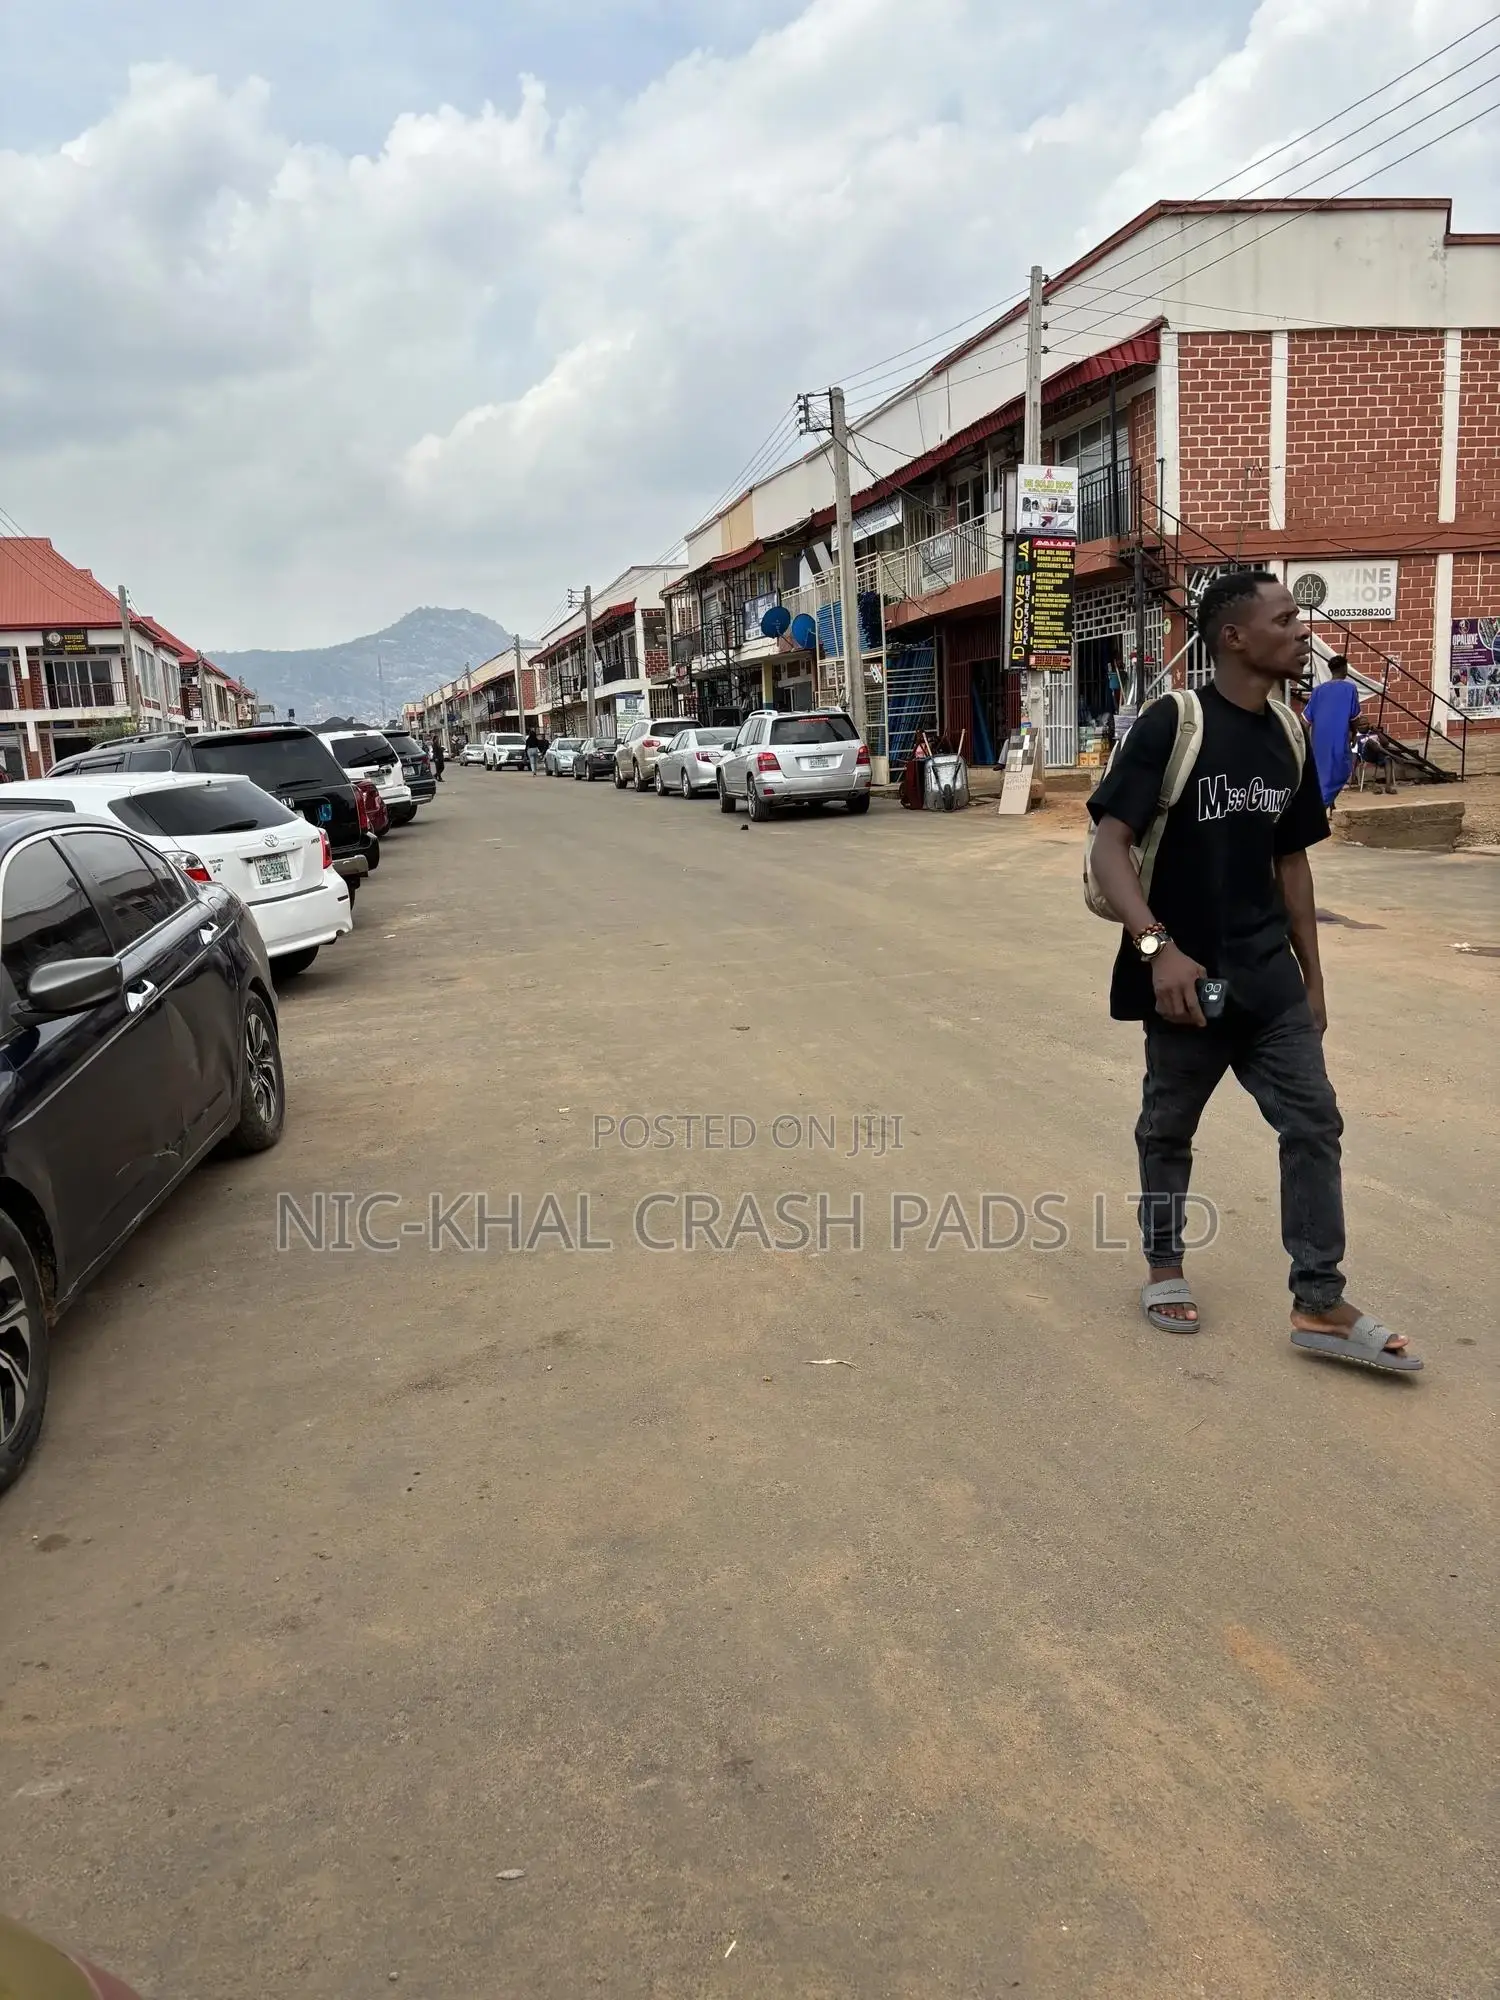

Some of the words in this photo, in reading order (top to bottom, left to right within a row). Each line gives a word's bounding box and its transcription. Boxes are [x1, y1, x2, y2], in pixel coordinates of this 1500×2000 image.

[1333, 568, 1391, 584] WINE
[1334, 586, 1392, 602] SHOP
[1012, 574, 1025, 660] DISCOVER
[1327, 607, 1392, 617] 08033288200
